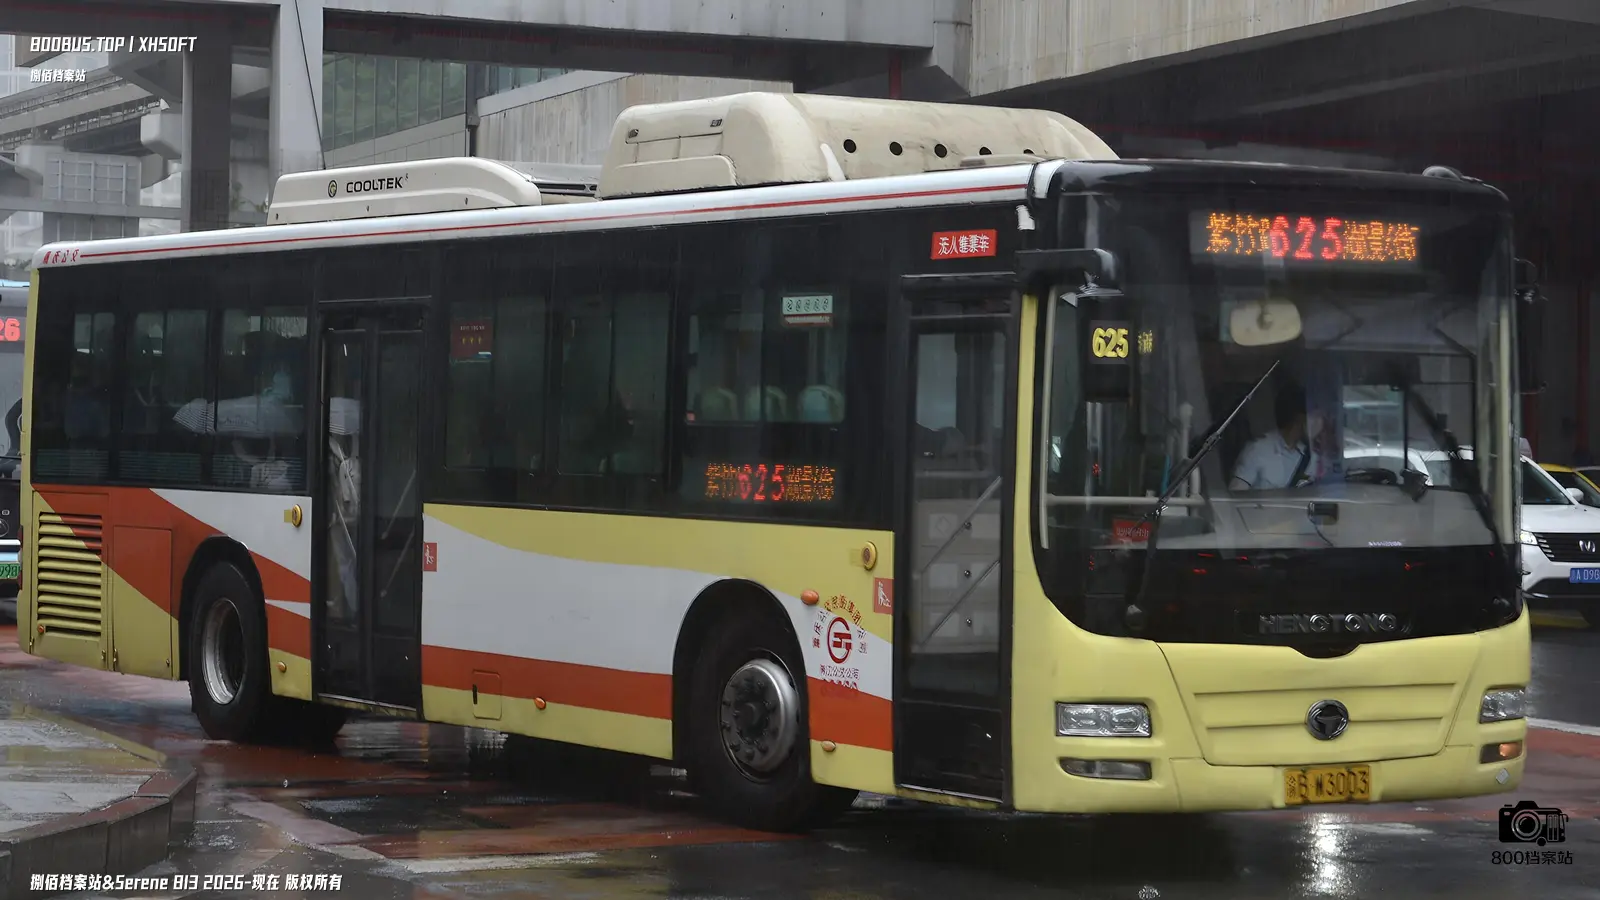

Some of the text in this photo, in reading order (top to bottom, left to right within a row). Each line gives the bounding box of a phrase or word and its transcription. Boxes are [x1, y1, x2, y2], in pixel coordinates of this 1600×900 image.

[346, 177, 403, 193] COOLTEK
[938, 233, 989, 255] 无人售票车
[1269, 215, 1342, 260] 625
[1093, 328, 1128, 358] 625
[738, 464, 785, 500] 625
[1259, 613, 1397, 634] HENGTONG
